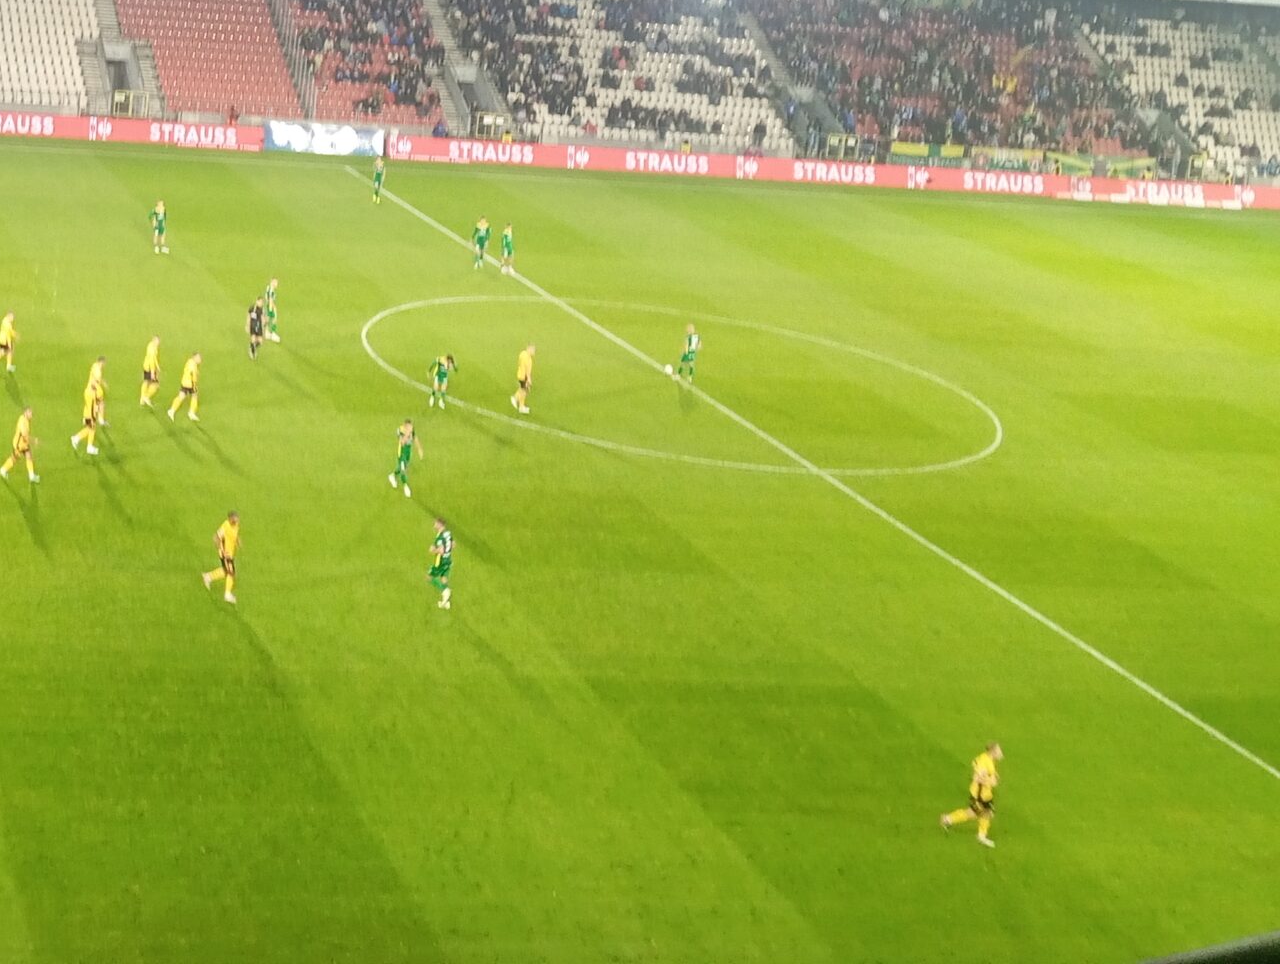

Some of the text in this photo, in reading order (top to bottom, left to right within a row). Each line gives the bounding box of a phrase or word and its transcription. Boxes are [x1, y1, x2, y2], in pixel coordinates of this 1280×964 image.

[150, 123, 237, 146] STRAUSS
[449, 141, 533, 164] STRAUSS
[626, 151, 709, 174] STRAUSS
[794, 161, 875, 184] STRAUSS
[963, 172, 1044, 194] STRAUSS
[1126, 182, 1204, 206] STRAUSS
